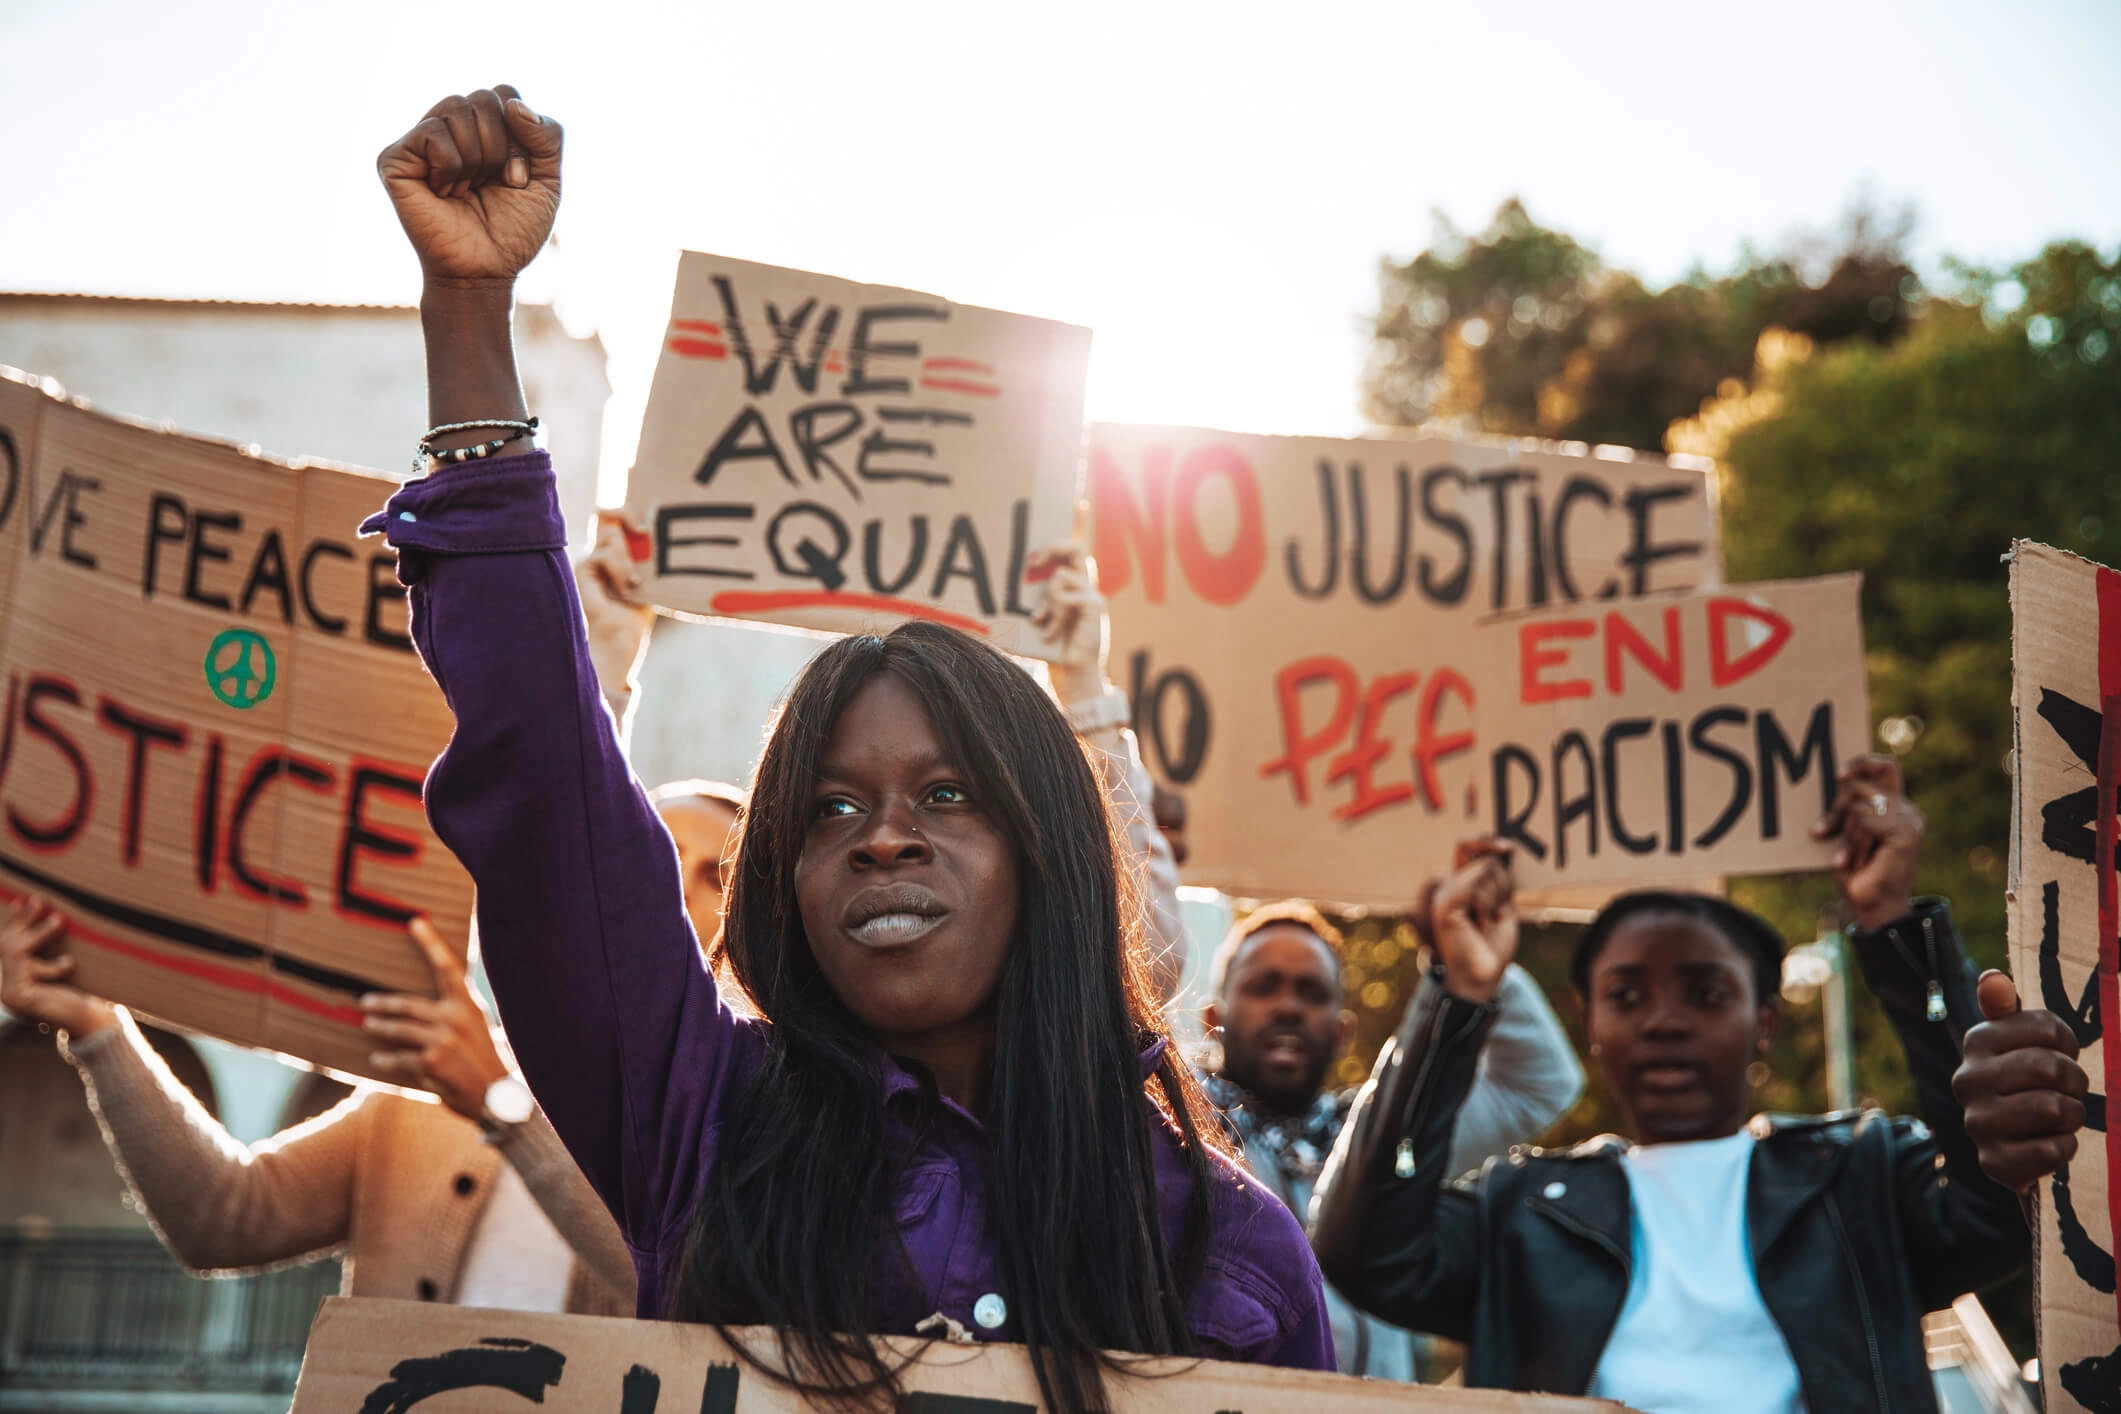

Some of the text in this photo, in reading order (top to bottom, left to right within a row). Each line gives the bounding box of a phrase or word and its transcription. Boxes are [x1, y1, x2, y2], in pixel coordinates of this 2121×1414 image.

[709, 274, 949, 395] WE
[695, 403, 974, 503] ARE
[143, 492, 416, 654] PEACE
[656, 500, 1033, 617] EQUAL
[1090, 443, 1705, 609] NO JUSTICE
[1519, 597, 1793, 705] END
[1492, 700, 1837, 870] RACISM
